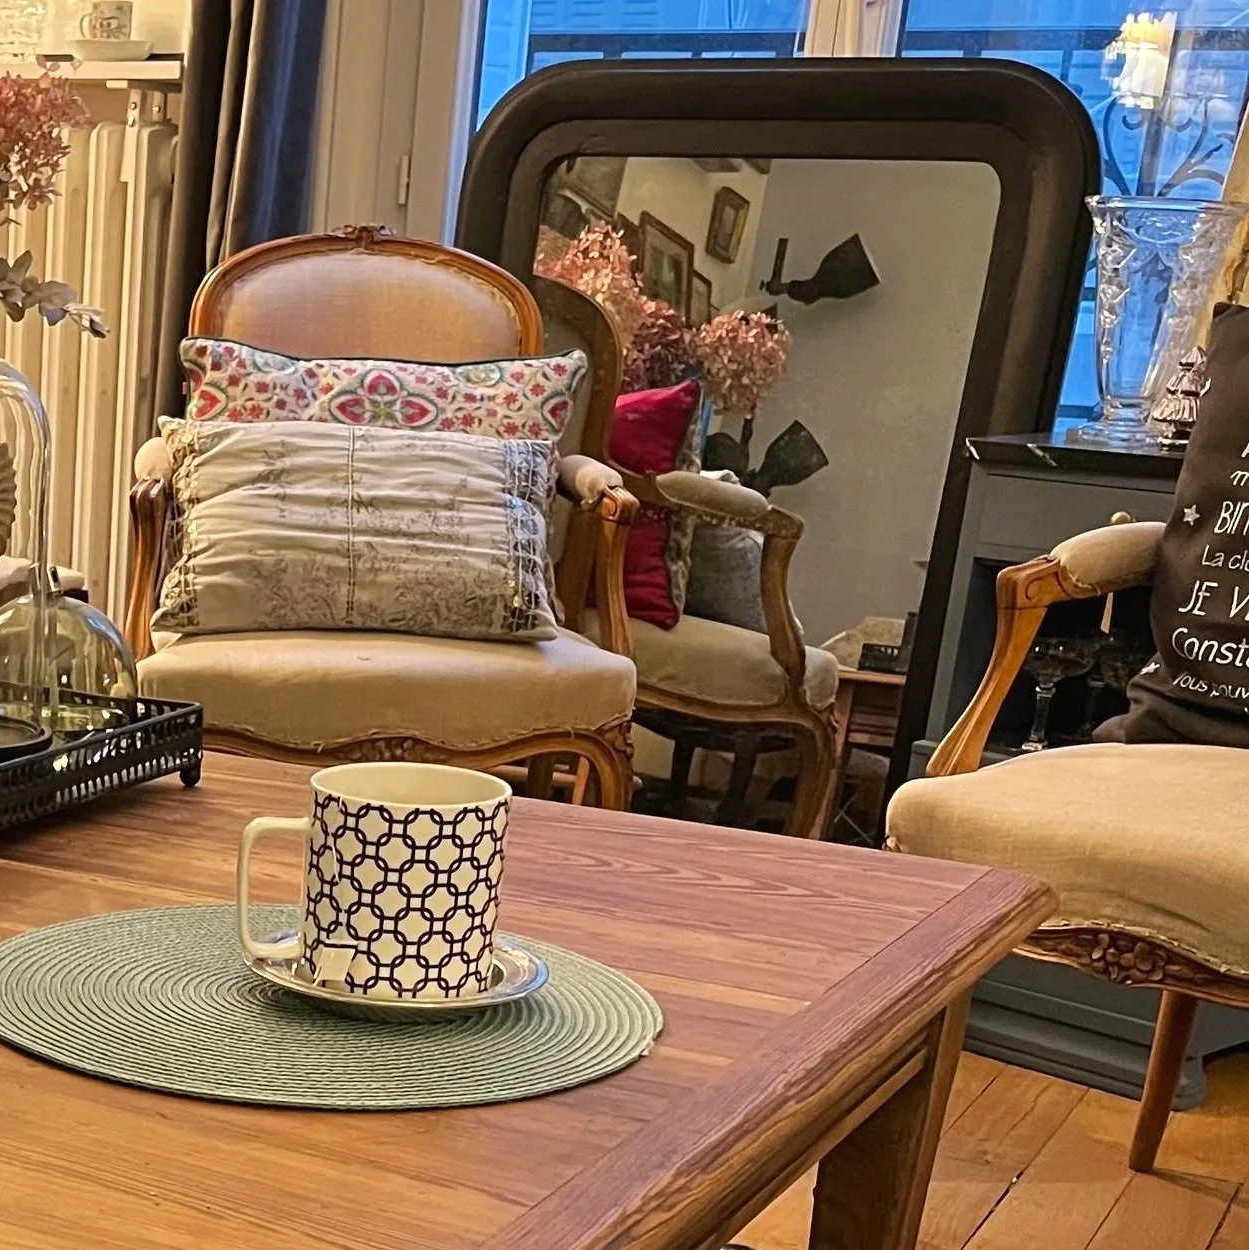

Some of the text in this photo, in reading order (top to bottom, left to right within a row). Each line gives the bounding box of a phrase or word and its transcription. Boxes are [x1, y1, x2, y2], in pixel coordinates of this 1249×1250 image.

[1201, 544, 1225, 567] La
[1178, 580, 1249, 621] JE V
